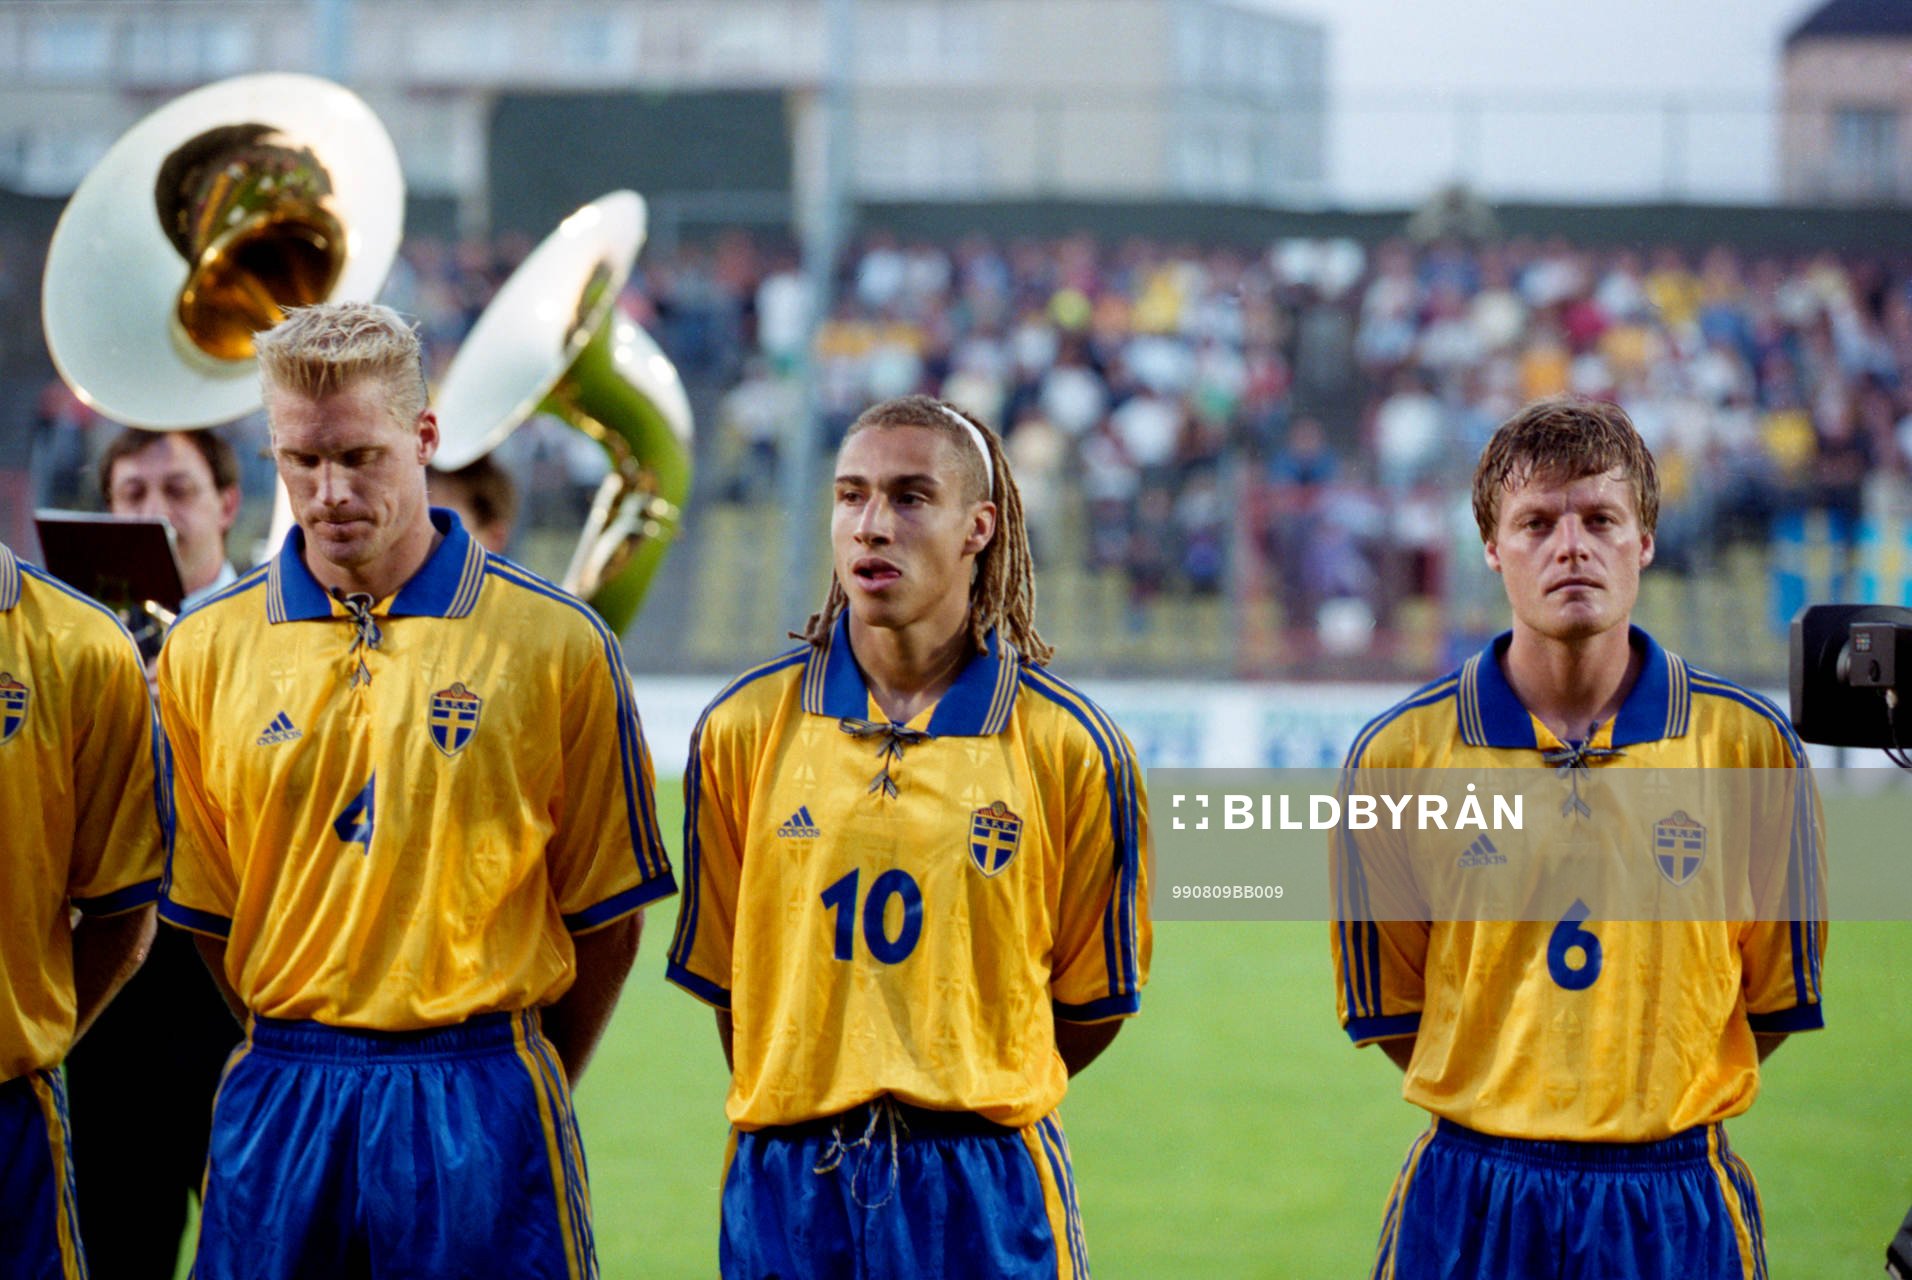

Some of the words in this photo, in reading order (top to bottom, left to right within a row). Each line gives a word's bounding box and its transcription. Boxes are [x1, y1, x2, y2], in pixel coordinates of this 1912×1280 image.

[333, 768, 376, 856] 4
[777, 825, 820, 838] adidas
[1456, 853, 1508, 868] adidas
[820, 867, 923, 965] 10
[1547, 898, 1603, 991] 6
